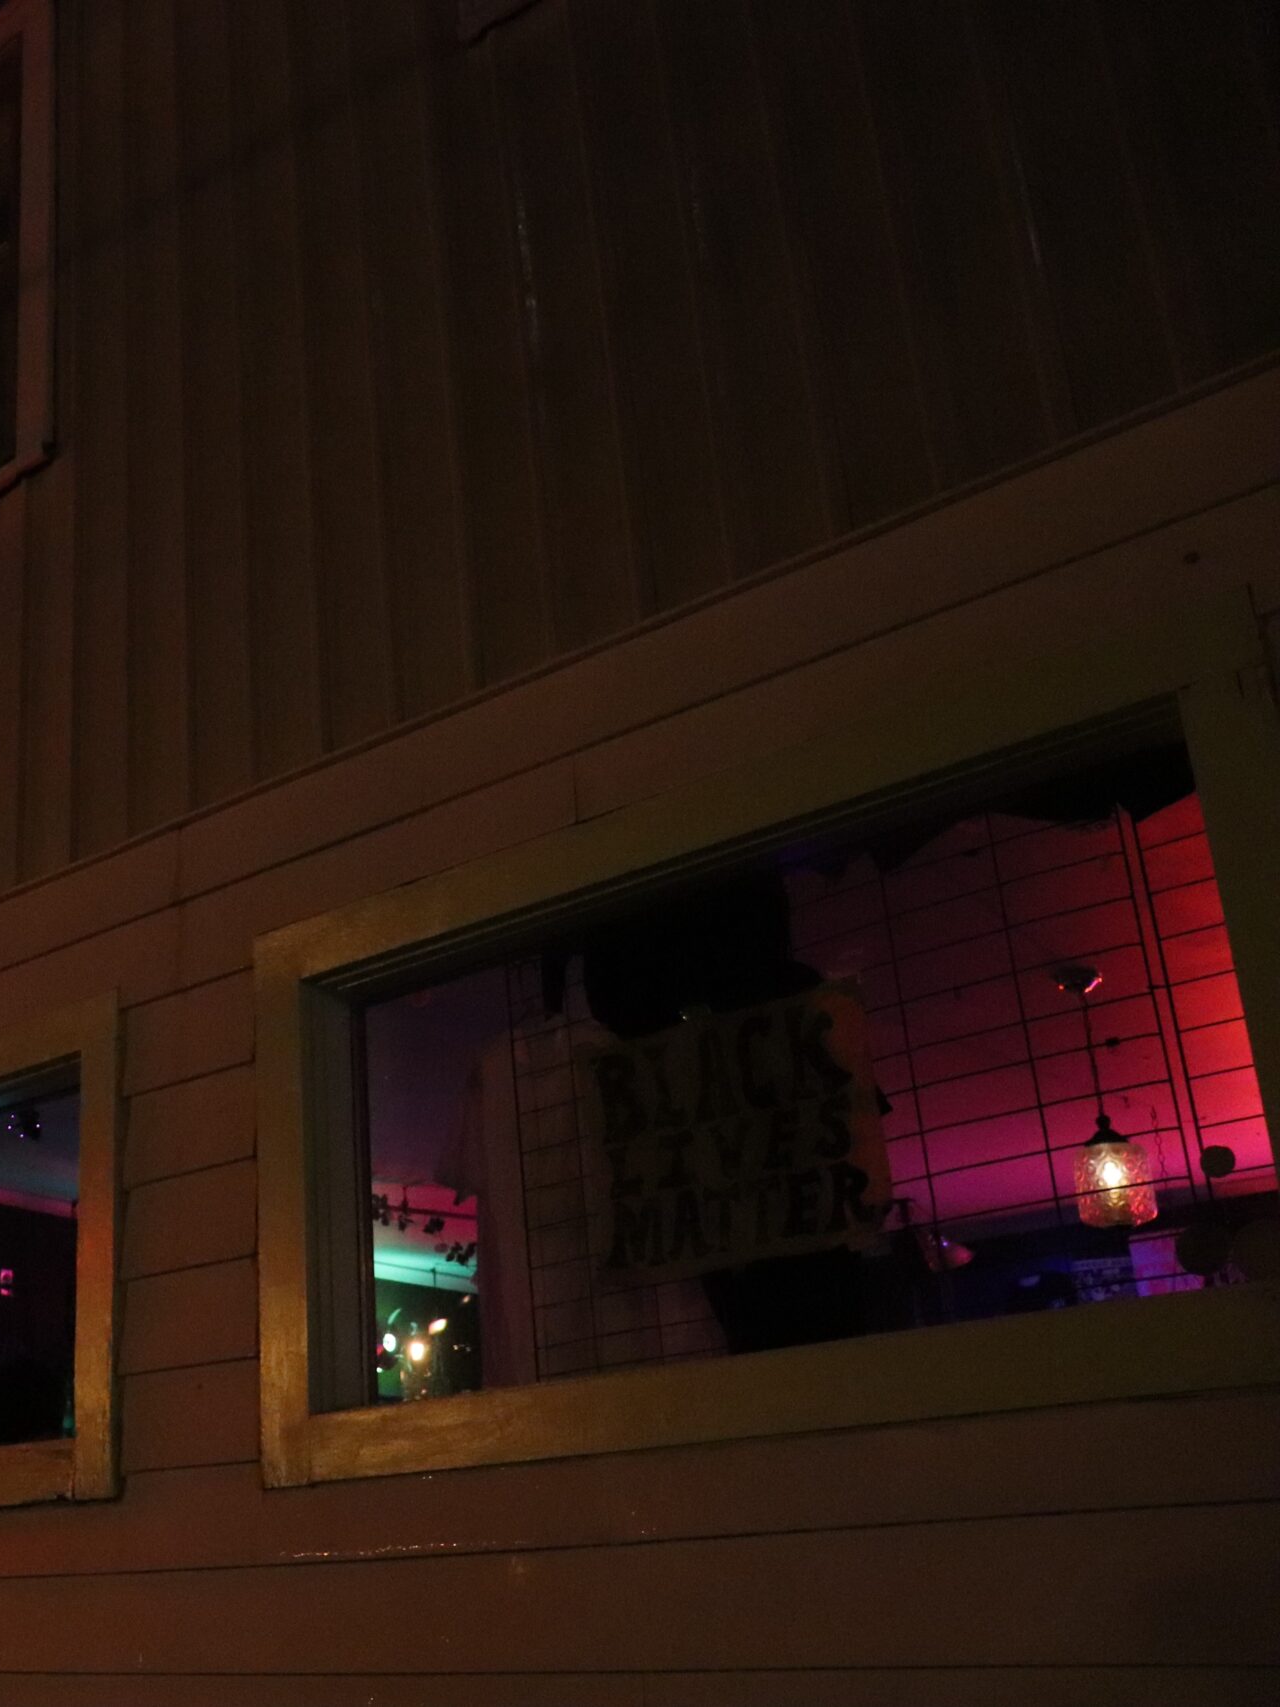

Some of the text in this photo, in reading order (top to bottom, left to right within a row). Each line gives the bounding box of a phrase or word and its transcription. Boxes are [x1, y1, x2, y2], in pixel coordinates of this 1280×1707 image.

[594, 1006, 853, 1142] BLACK
[609, 1092, 852, 1197] LIVES
[608, 1160, 878, 1267] MATTER
